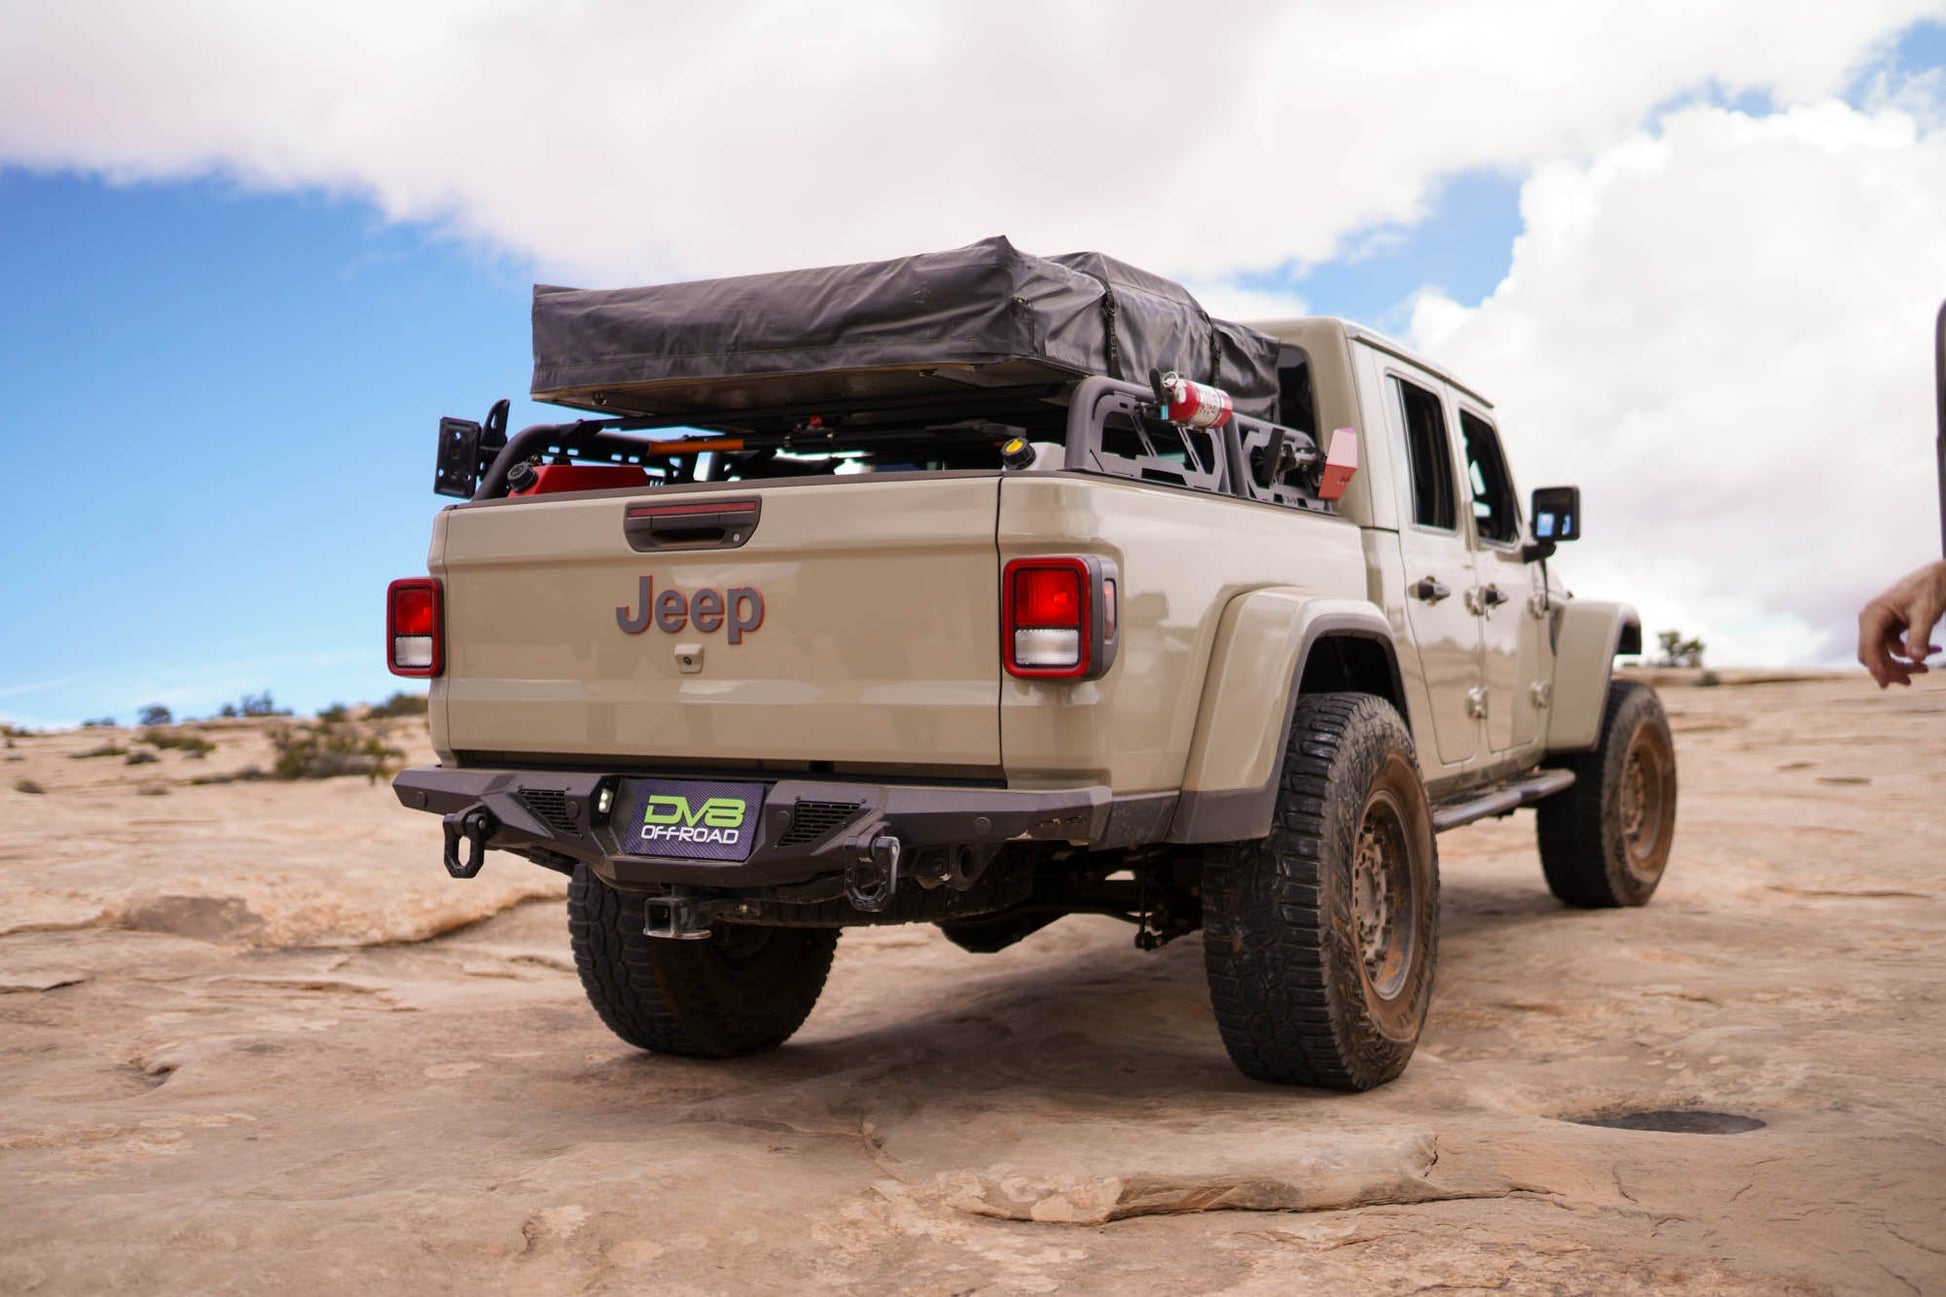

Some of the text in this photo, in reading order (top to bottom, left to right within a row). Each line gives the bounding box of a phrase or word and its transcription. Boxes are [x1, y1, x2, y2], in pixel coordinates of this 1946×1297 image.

[616, 574, 764, 644] Jeep
[644, 795, 746, 827] DV8
[641, 825, 739, 844] OFFROAD
